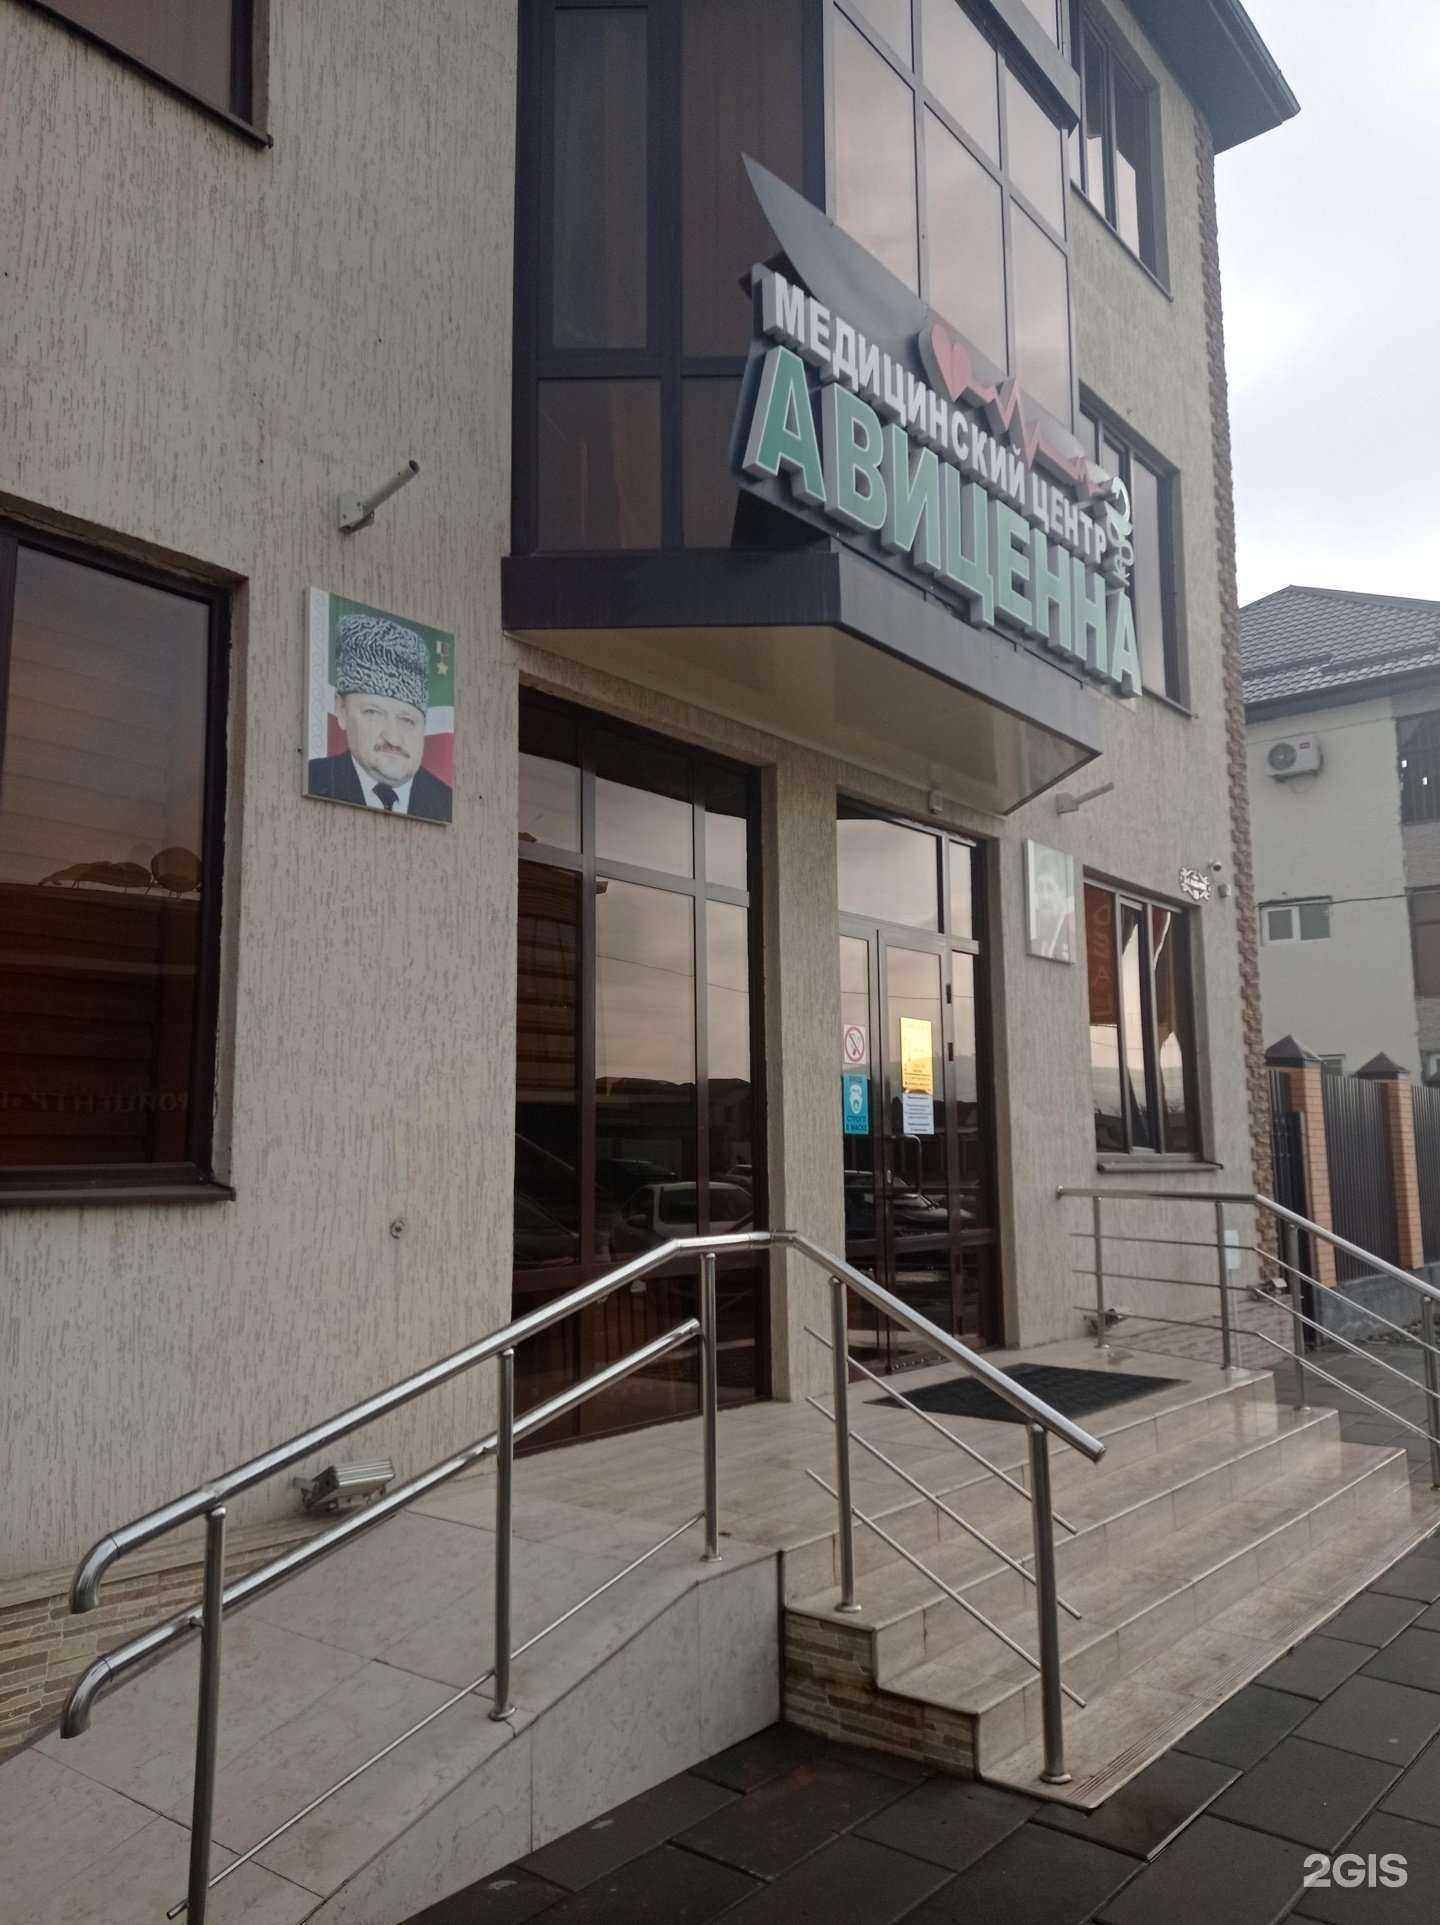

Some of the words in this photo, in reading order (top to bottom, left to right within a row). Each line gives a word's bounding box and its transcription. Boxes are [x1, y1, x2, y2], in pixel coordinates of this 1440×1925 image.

[745, 345, 1143, 698] АВИЦЕННА
[771, 269, 1026, 506] МЕДИЦИНСКИЙ
[1029, 472, 1107, 566] ЦЕНТР
